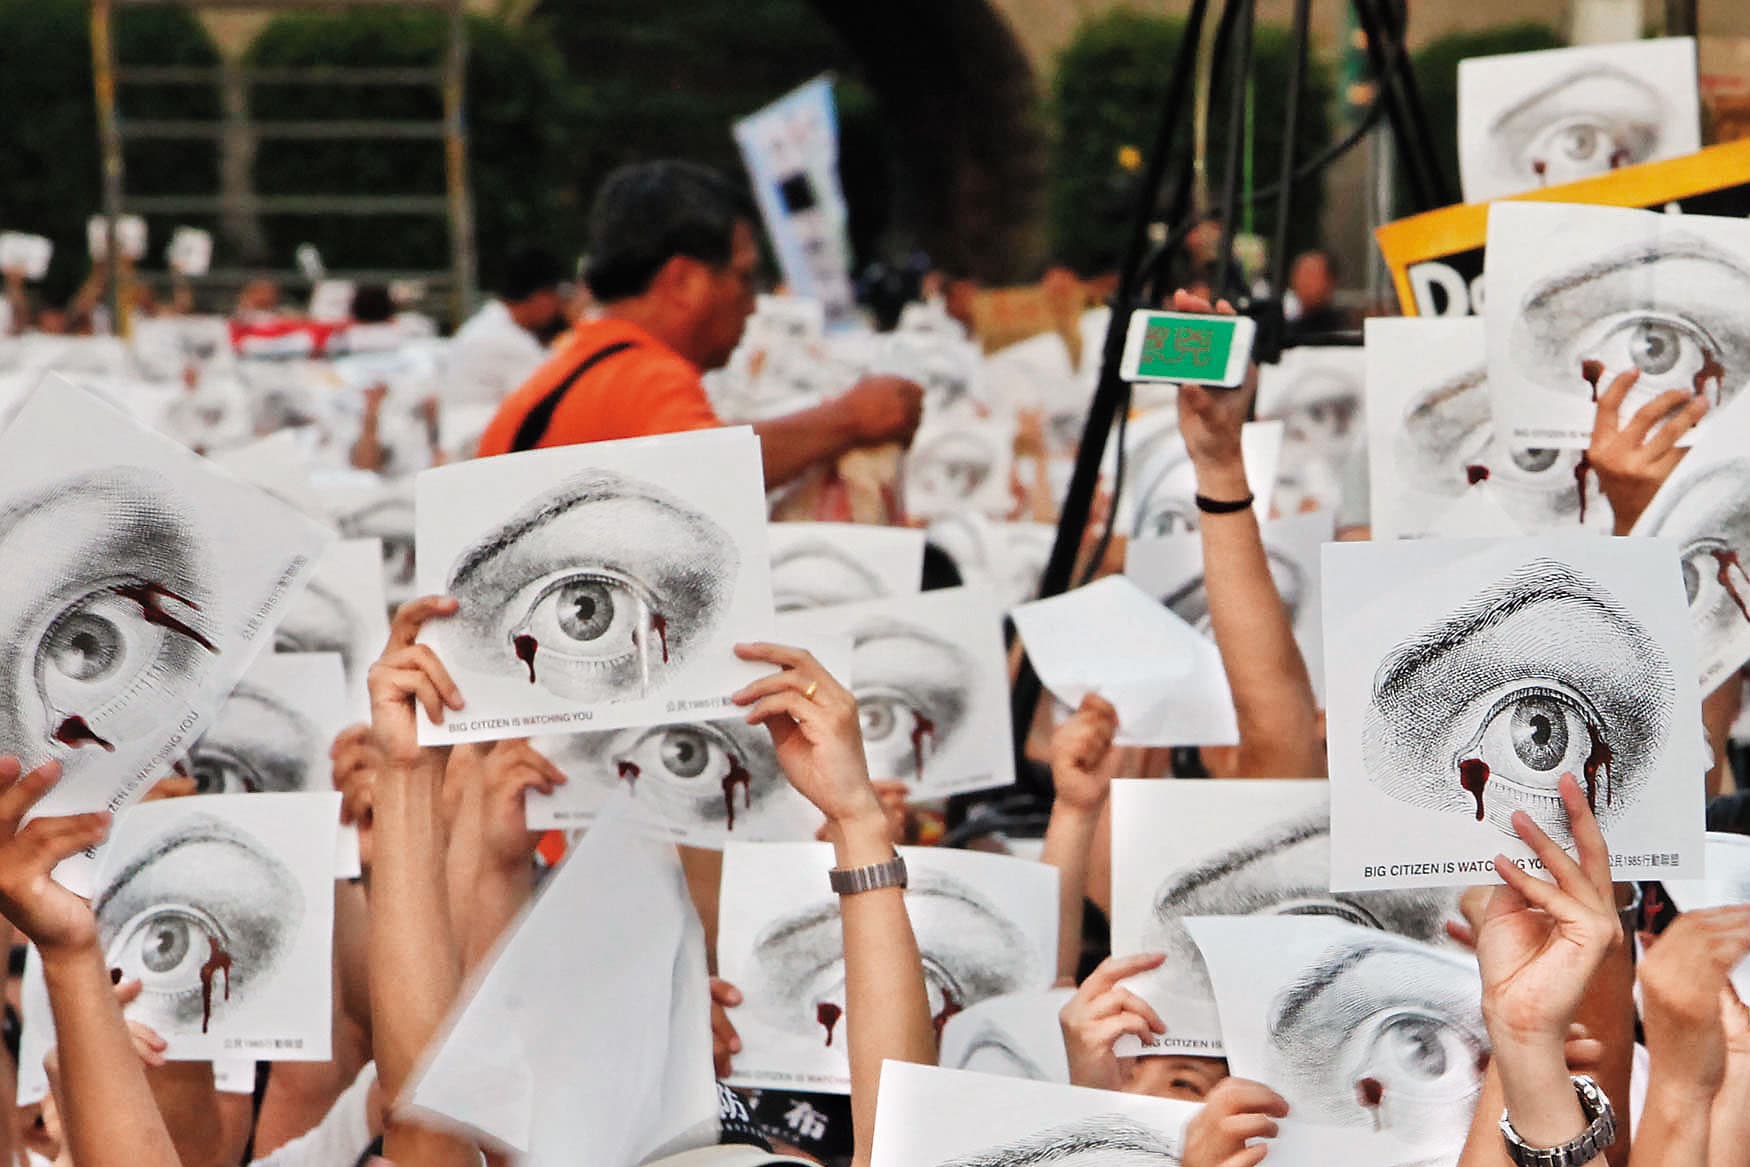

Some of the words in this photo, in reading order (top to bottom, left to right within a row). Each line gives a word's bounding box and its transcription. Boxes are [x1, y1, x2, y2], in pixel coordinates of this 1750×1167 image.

[449, 721, 468, 733] BIG
[471, 717, 510, 730] CITIZEN
[512, 717, 521, 727] IS
[523, 713, 571, 726] WATCHING
[573, 710, 593, 721] YOU
[1364, 866, 1387, 878] BIG
[1390, 863, 1440, 876] CITIZEN
[1443, 862, 1455, 874] IS
[1457, 859, 1526, 873] WATCG
[1528, 858, 1547, 870] YO
[1164, 1038, 1208, 1048] CITIZEN
